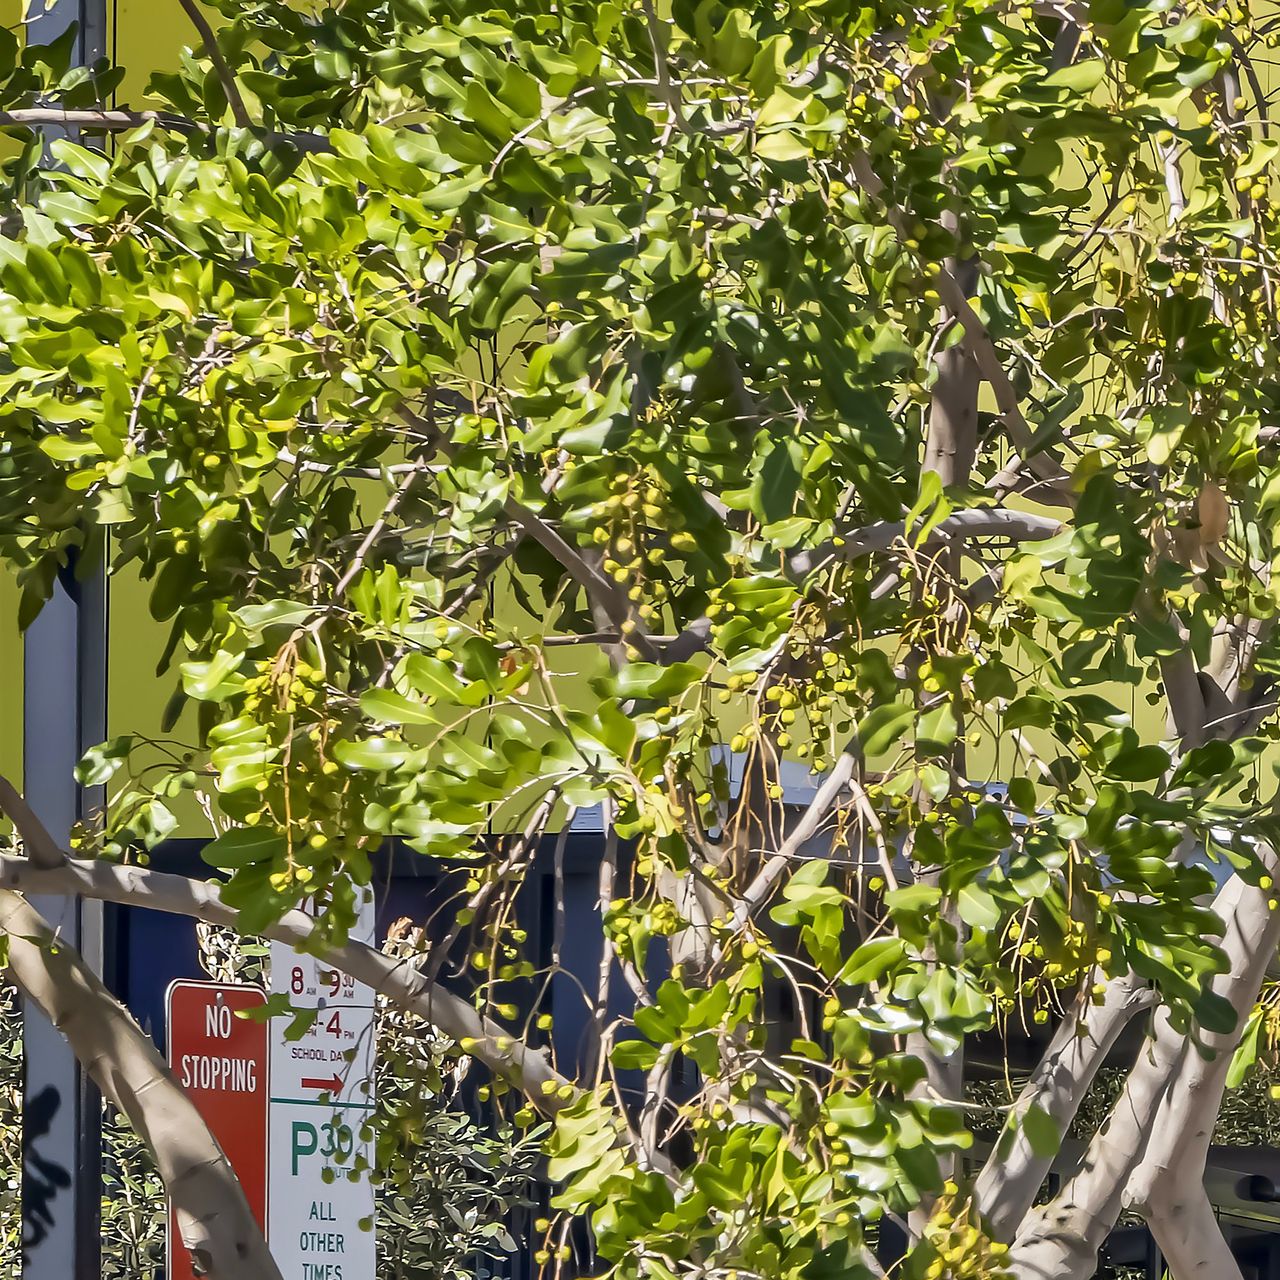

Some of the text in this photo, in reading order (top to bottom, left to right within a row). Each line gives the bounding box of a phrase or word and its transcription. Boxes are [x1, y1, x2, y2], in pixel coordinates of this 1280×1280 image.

[291, 966, 304, 995] 8
[306, 987, 317, 996] AM
[343, 990, 355, 999] AM
[206, 1004, 232, 1039] NO
[343, 1030, 355, 1040] PM
[291, 1047, 328, 1062] SCHOOL
[181, 1054, 256, 1093] STOPPING
[309, 1201, 337, 1221] ALL
[300, 1231, 345, 1253] OTHER
